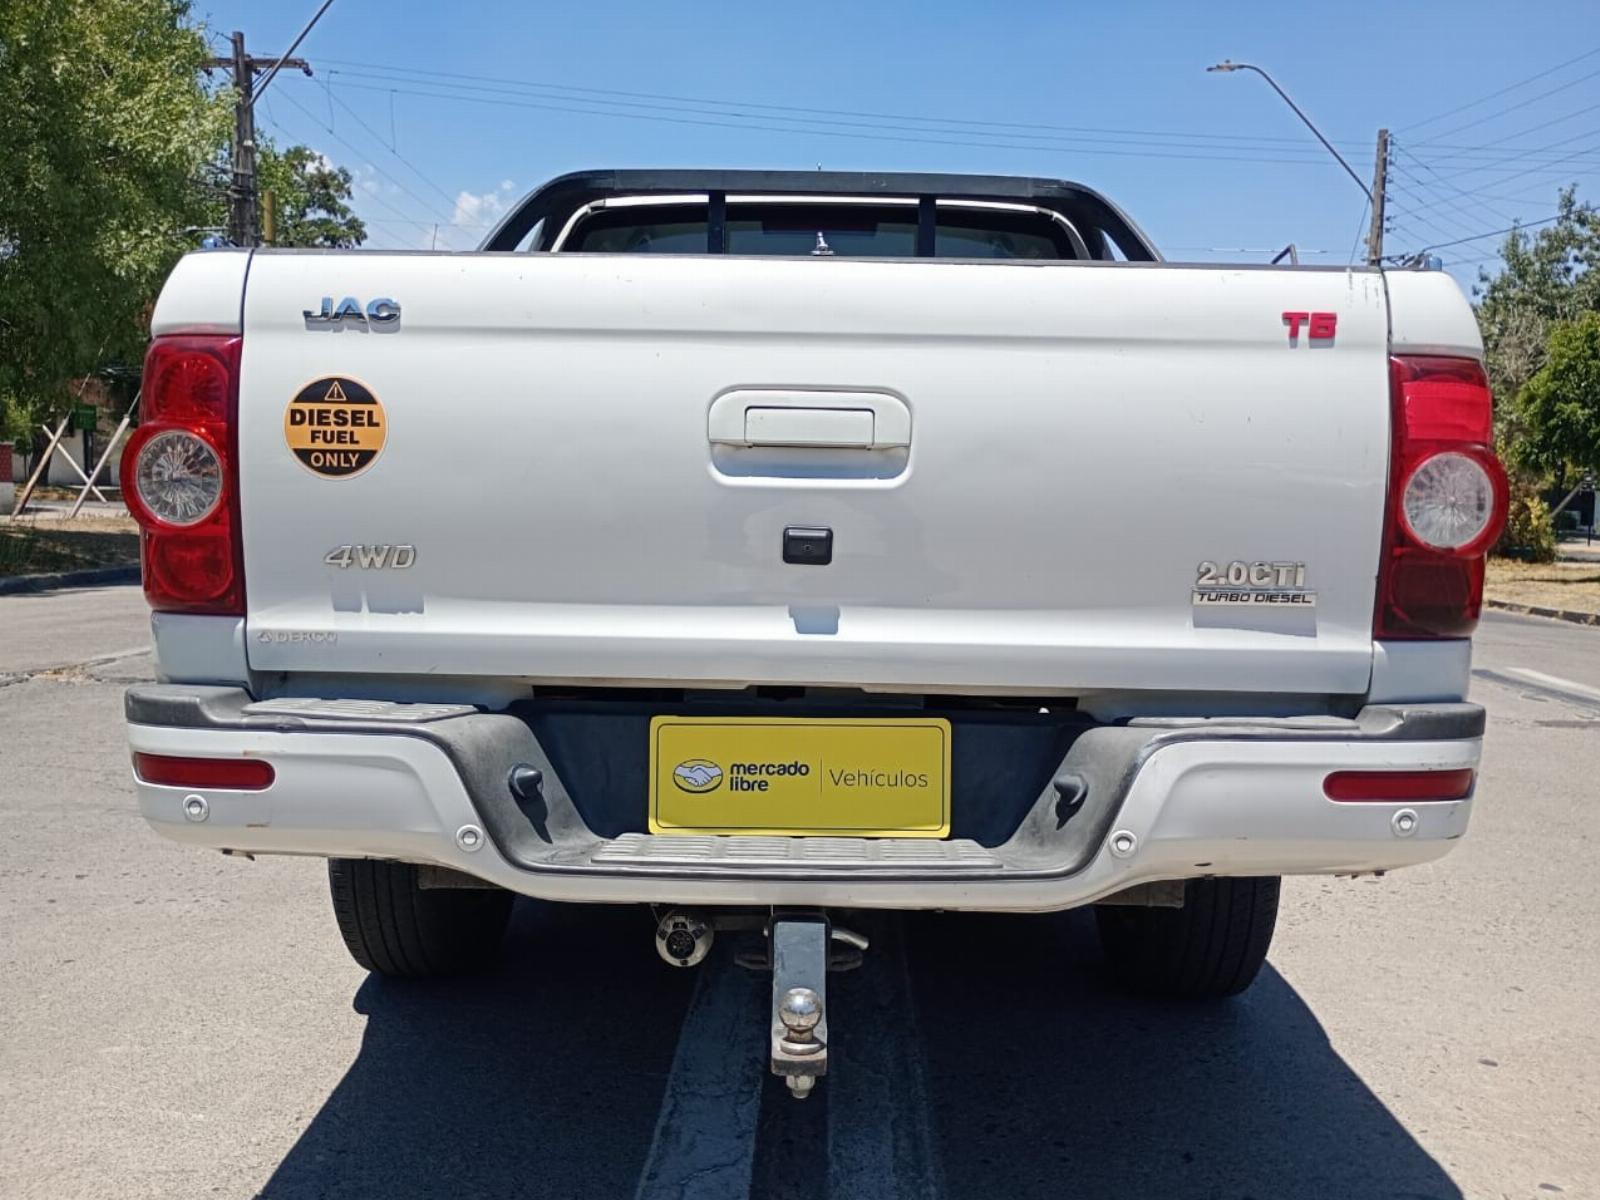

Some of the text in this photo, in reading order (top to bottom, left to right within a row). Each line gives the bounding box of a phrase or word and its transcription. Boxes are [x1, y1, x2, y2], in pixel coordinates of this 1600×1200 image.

[302, 297, 401, 321] JAC
[1282, 312, 1337, 339] T6
[290, 409, 380, 427] DIESEL
[310, 430, 360, 445] FUEL
[310, 452, 359, 467] ONLY
[324, 545, 417, 568] 4WD
[1197, 561, 1306, 588] 2.0CTi
[1199, 592, 1312, 604] TURBO DIESEL
[730, 761, 810, 777] mercado
[829, 768, 929, 788] Vehículos
[730, 777, 769, 792] libre
